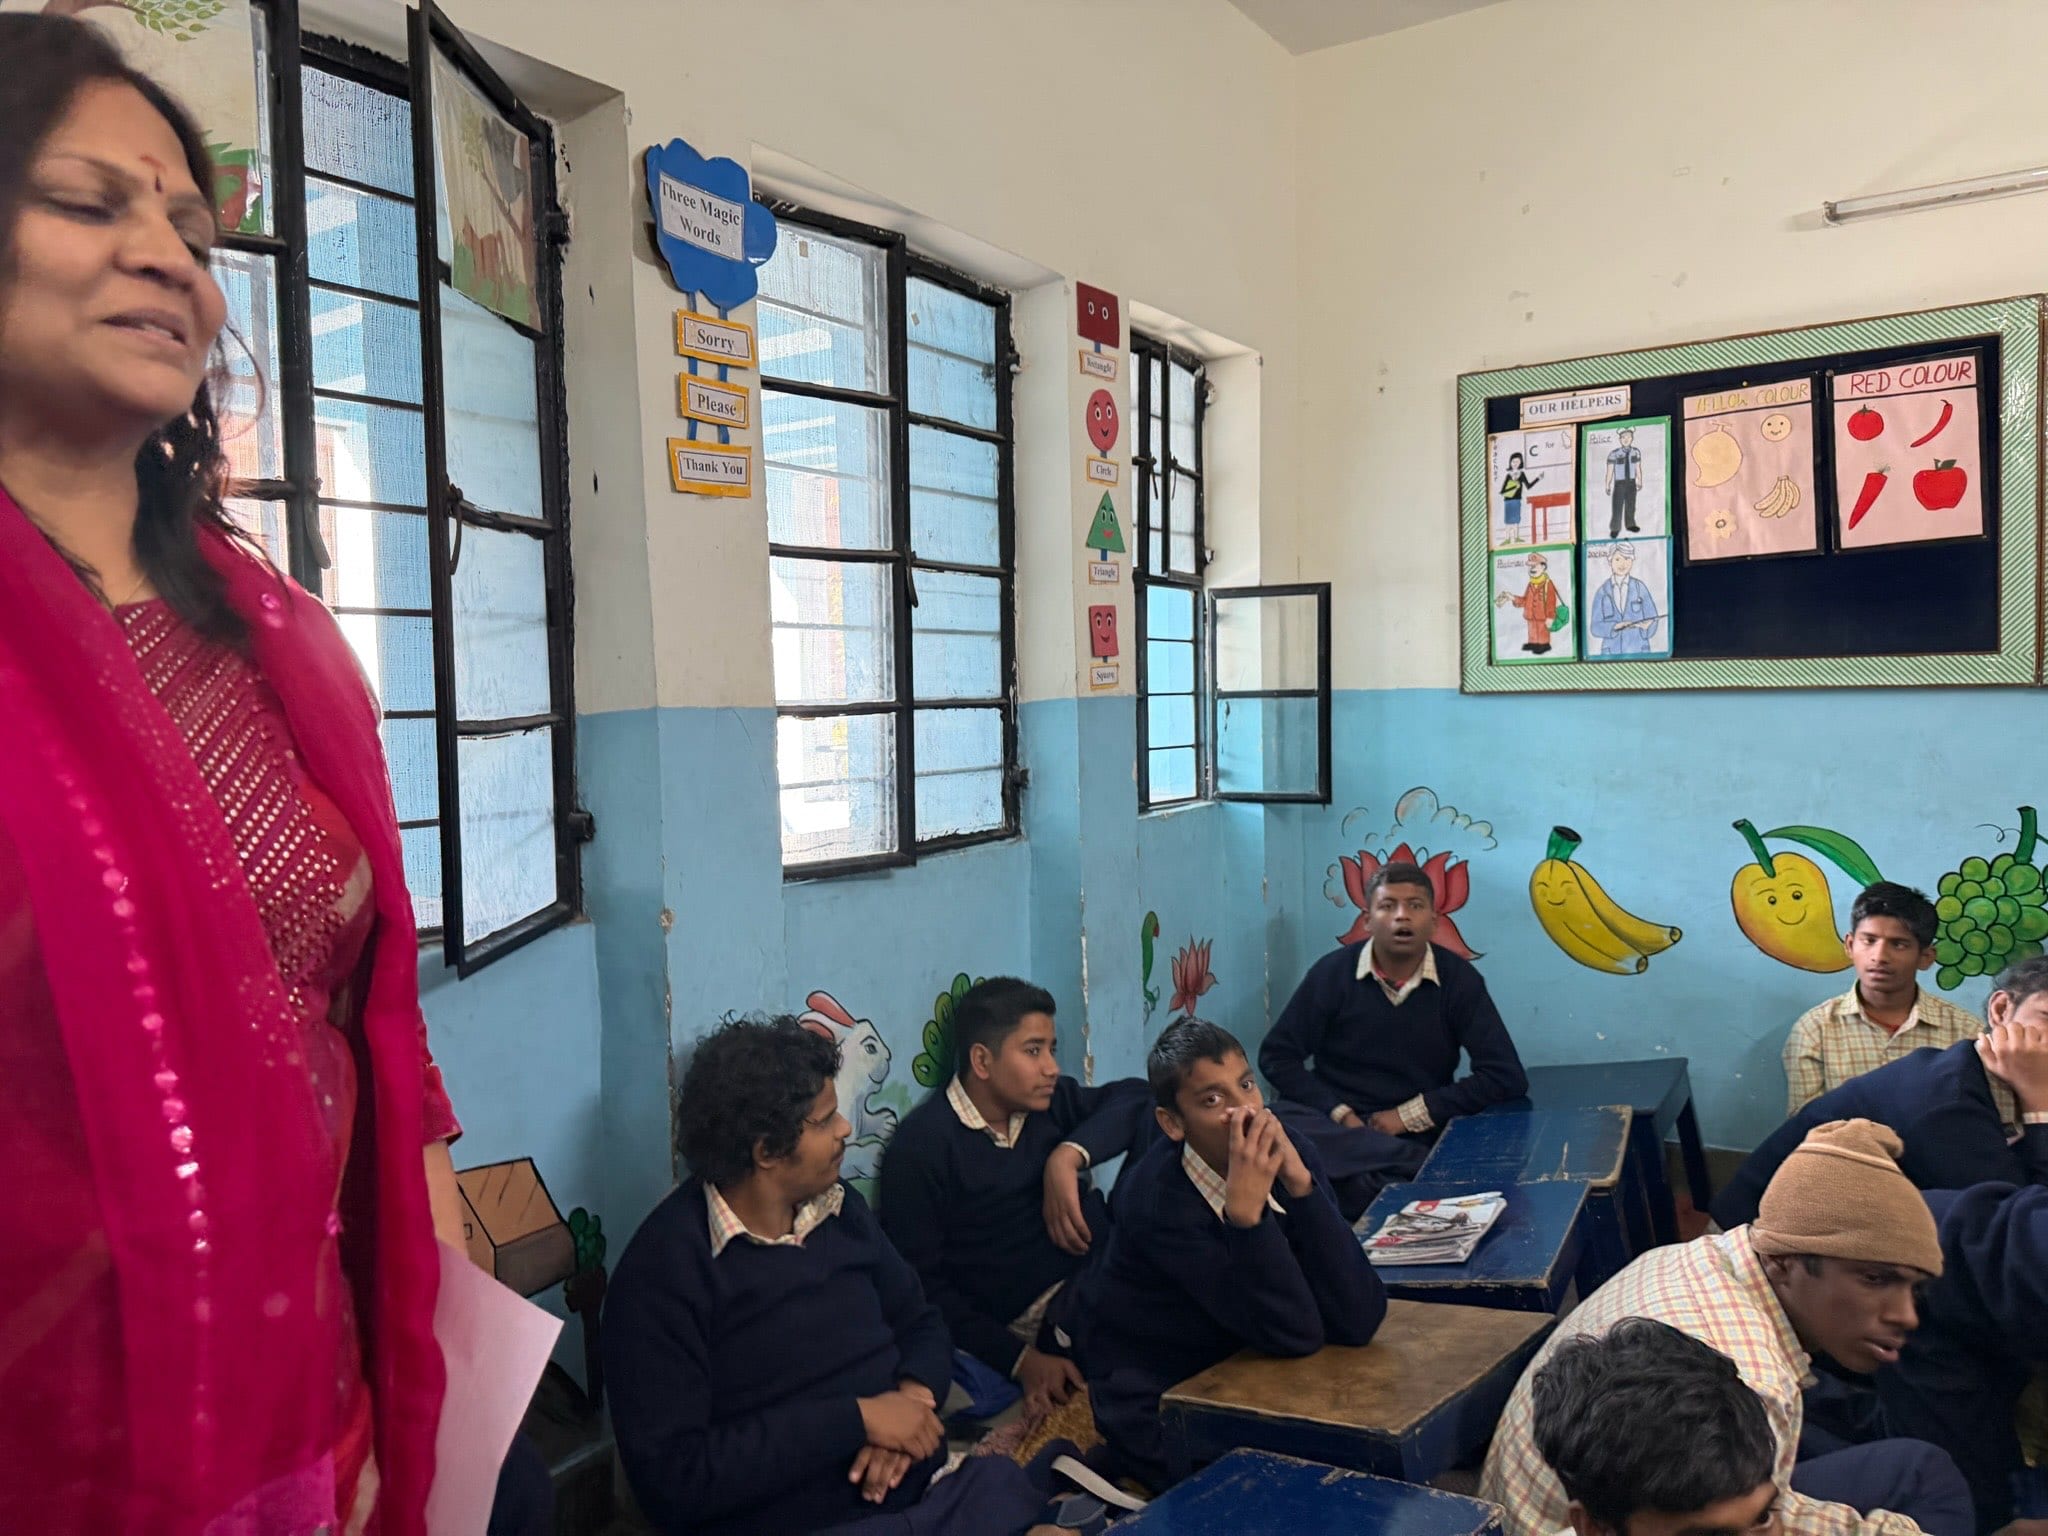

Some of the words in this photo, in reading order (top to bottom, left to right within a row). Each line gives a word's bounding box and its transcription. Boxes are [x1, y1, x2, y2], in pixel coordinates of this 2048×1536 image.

[661, 181, 697, 210] Three
[700, 198, 741, 226] Magic
[680, 214, 721, 246] Words
[697, 328, 735, 353] Sorry
[1850, 373, 1891, 396] RED
[1899, 360, 1972, 389] COLOUR
[697, 393, 737, 417] Please
[1528, 403, 1558, 415] OUR
[1560, 394, 1622, 411] HELPERS
[1756, 383, 1809, 404] COLOUR
[1528, 444, 1539, 457] C
[683, 456, 719, 474] Thank
[721, 461, 743, 475] You
